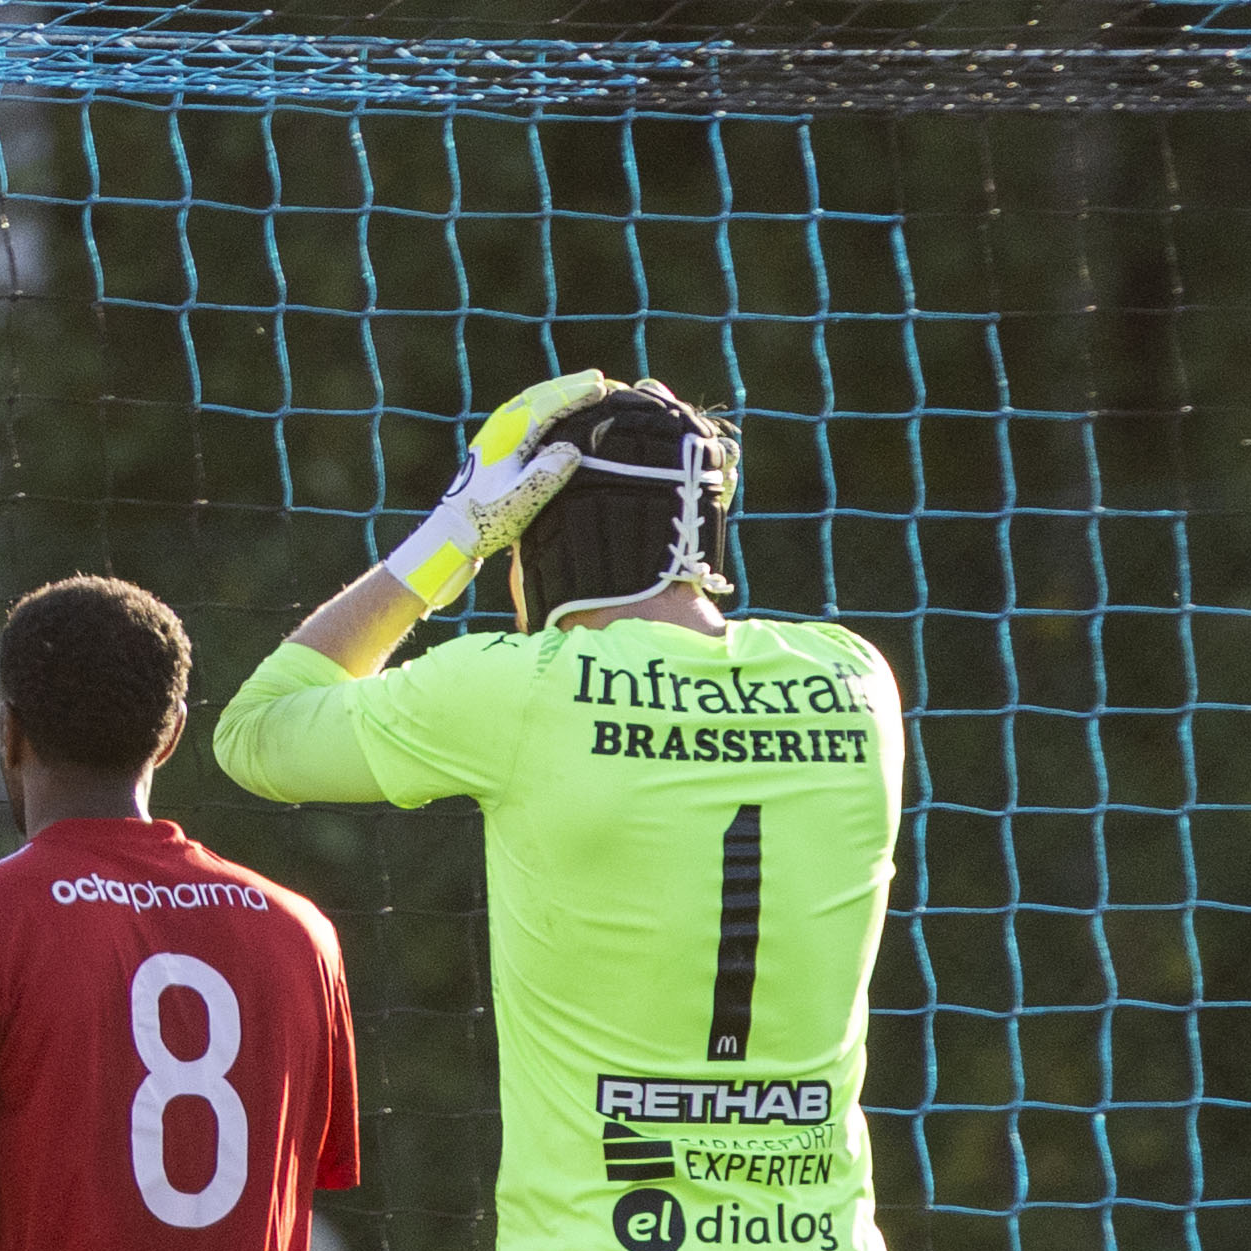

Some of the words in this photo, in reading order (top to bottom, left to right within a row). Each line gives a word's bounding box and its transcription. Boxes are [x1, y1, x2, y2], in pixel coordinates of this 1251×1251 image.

[591, 720, 868, 763] BRASSERIET
[51, 872, 269, 914] octapharma
[707, 804, 762, 1062] 1
[131, 952, 249, 1229] 8
[598, 1076, 832, 1124] RETHAB
[686, 1150, 833, 1186] EXPERTEN
[695, 1203, 838, 1251] dialog
